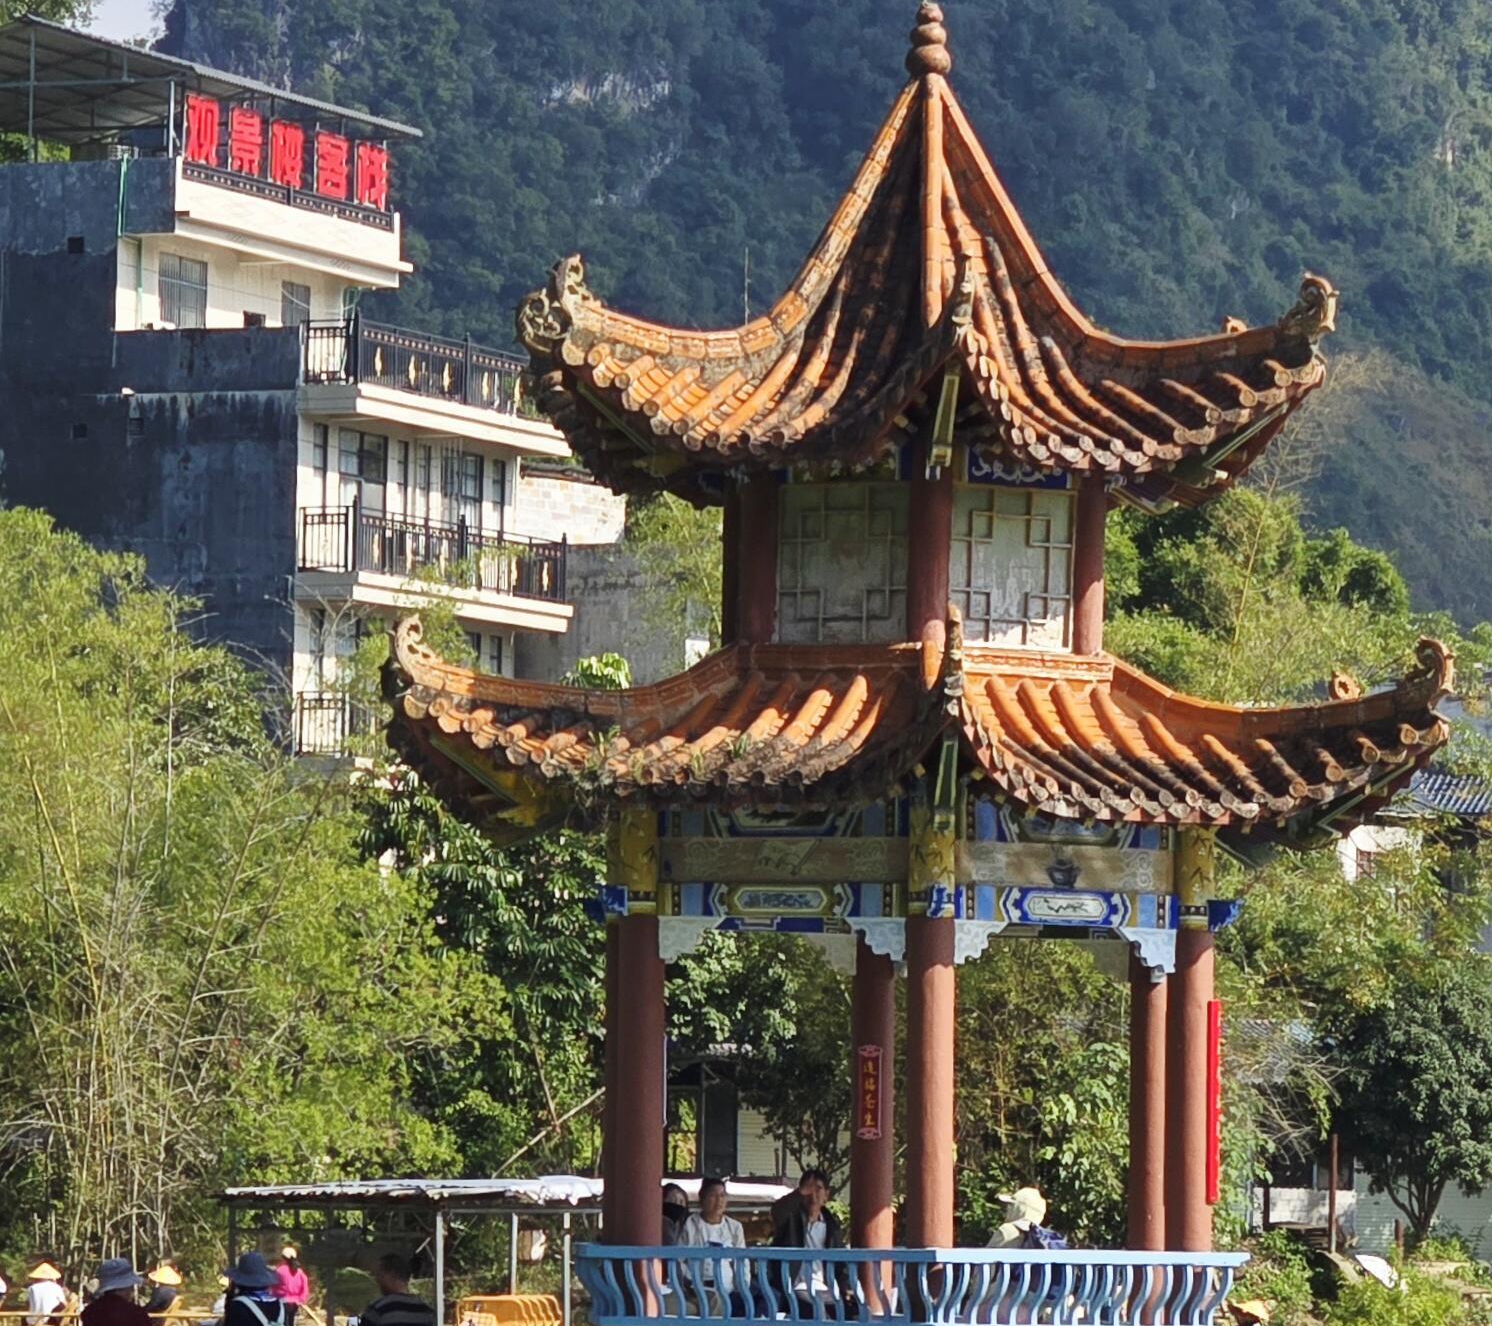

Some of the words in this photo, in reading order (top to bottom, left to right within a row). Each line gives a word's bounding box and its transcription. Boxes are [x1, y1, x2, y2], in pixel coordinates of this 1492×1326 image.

[186, 94, 390, 211] 观景楼客栈
